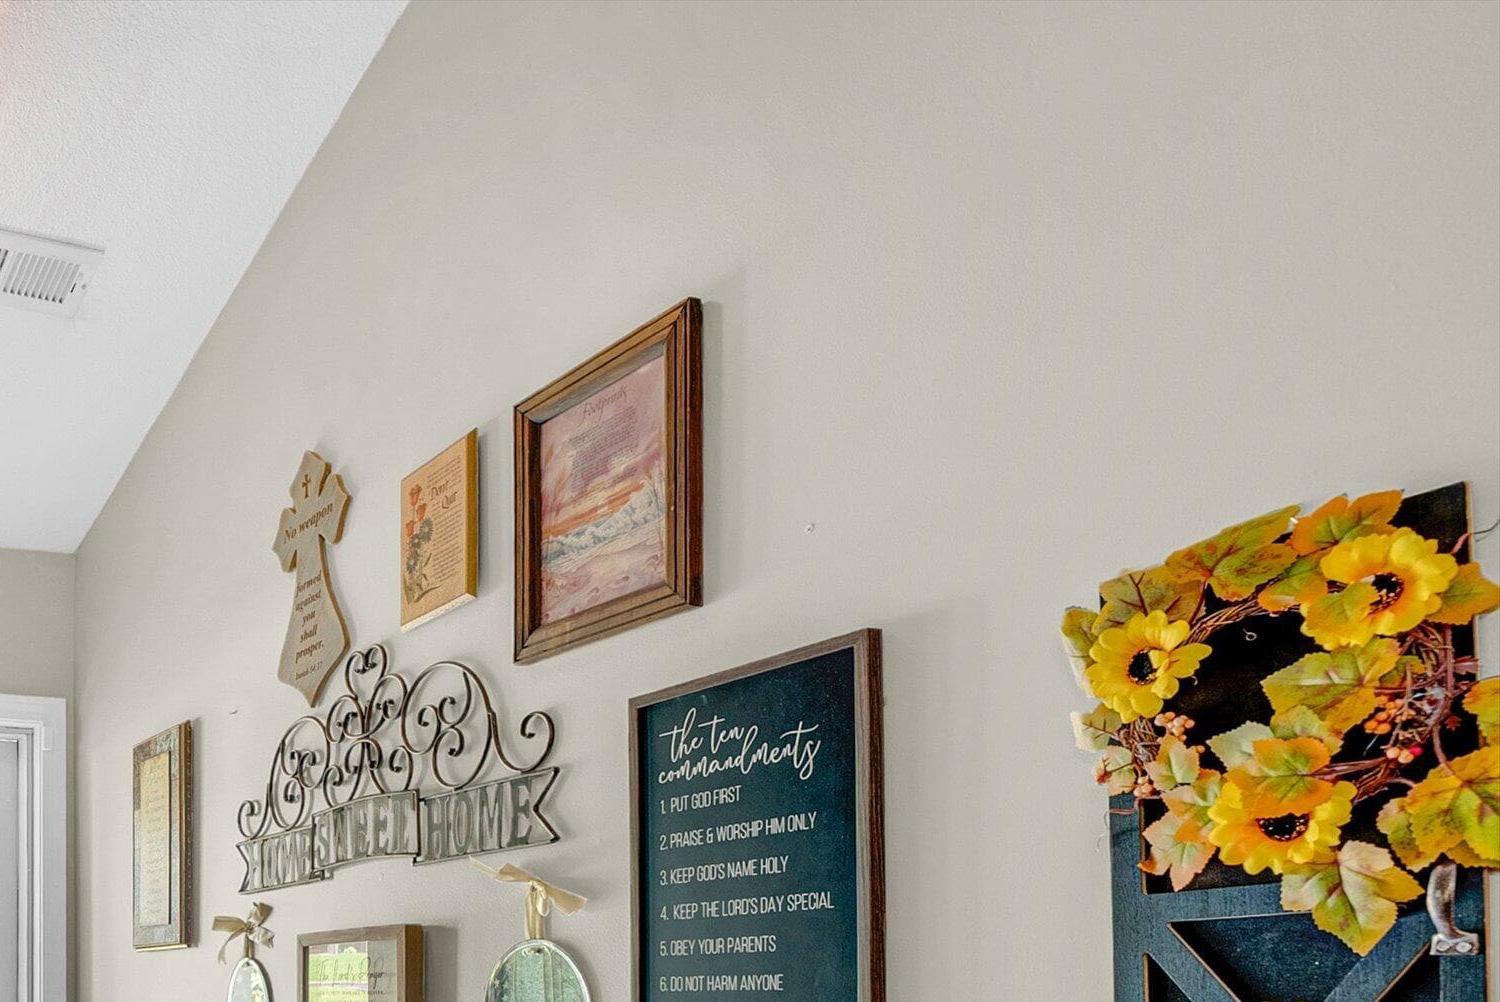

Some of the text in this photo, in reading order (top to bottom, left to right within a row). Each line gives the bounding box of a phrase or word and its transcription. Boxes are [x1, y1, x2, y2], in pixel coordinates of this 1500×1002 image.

[284, 502, 333, 541] No weapon
[658, 721, 822, 784] commandments
[659, 708, 745, 763] the ten
[660, 785, 742, 814] 1. PUT GOD FIRST
[316, 794, 417, 867] SWEET
[419, 779, 534, 860] HOME
[660, 811, 817, 851] 2. PRAISE & WORSHIP HIM ONLY
[660, 855, 789, 886] 3. KEEP GOD'S NAME HOLY
[660, 891, 835, 921] 4. KEEP THE LORD'S DAY SPECIAL
[660, 935, 777, 956] 5. OBEY YOUR PARENTS
[660, 974, 784, 992] 6. DO NOT HARM ANYONE
